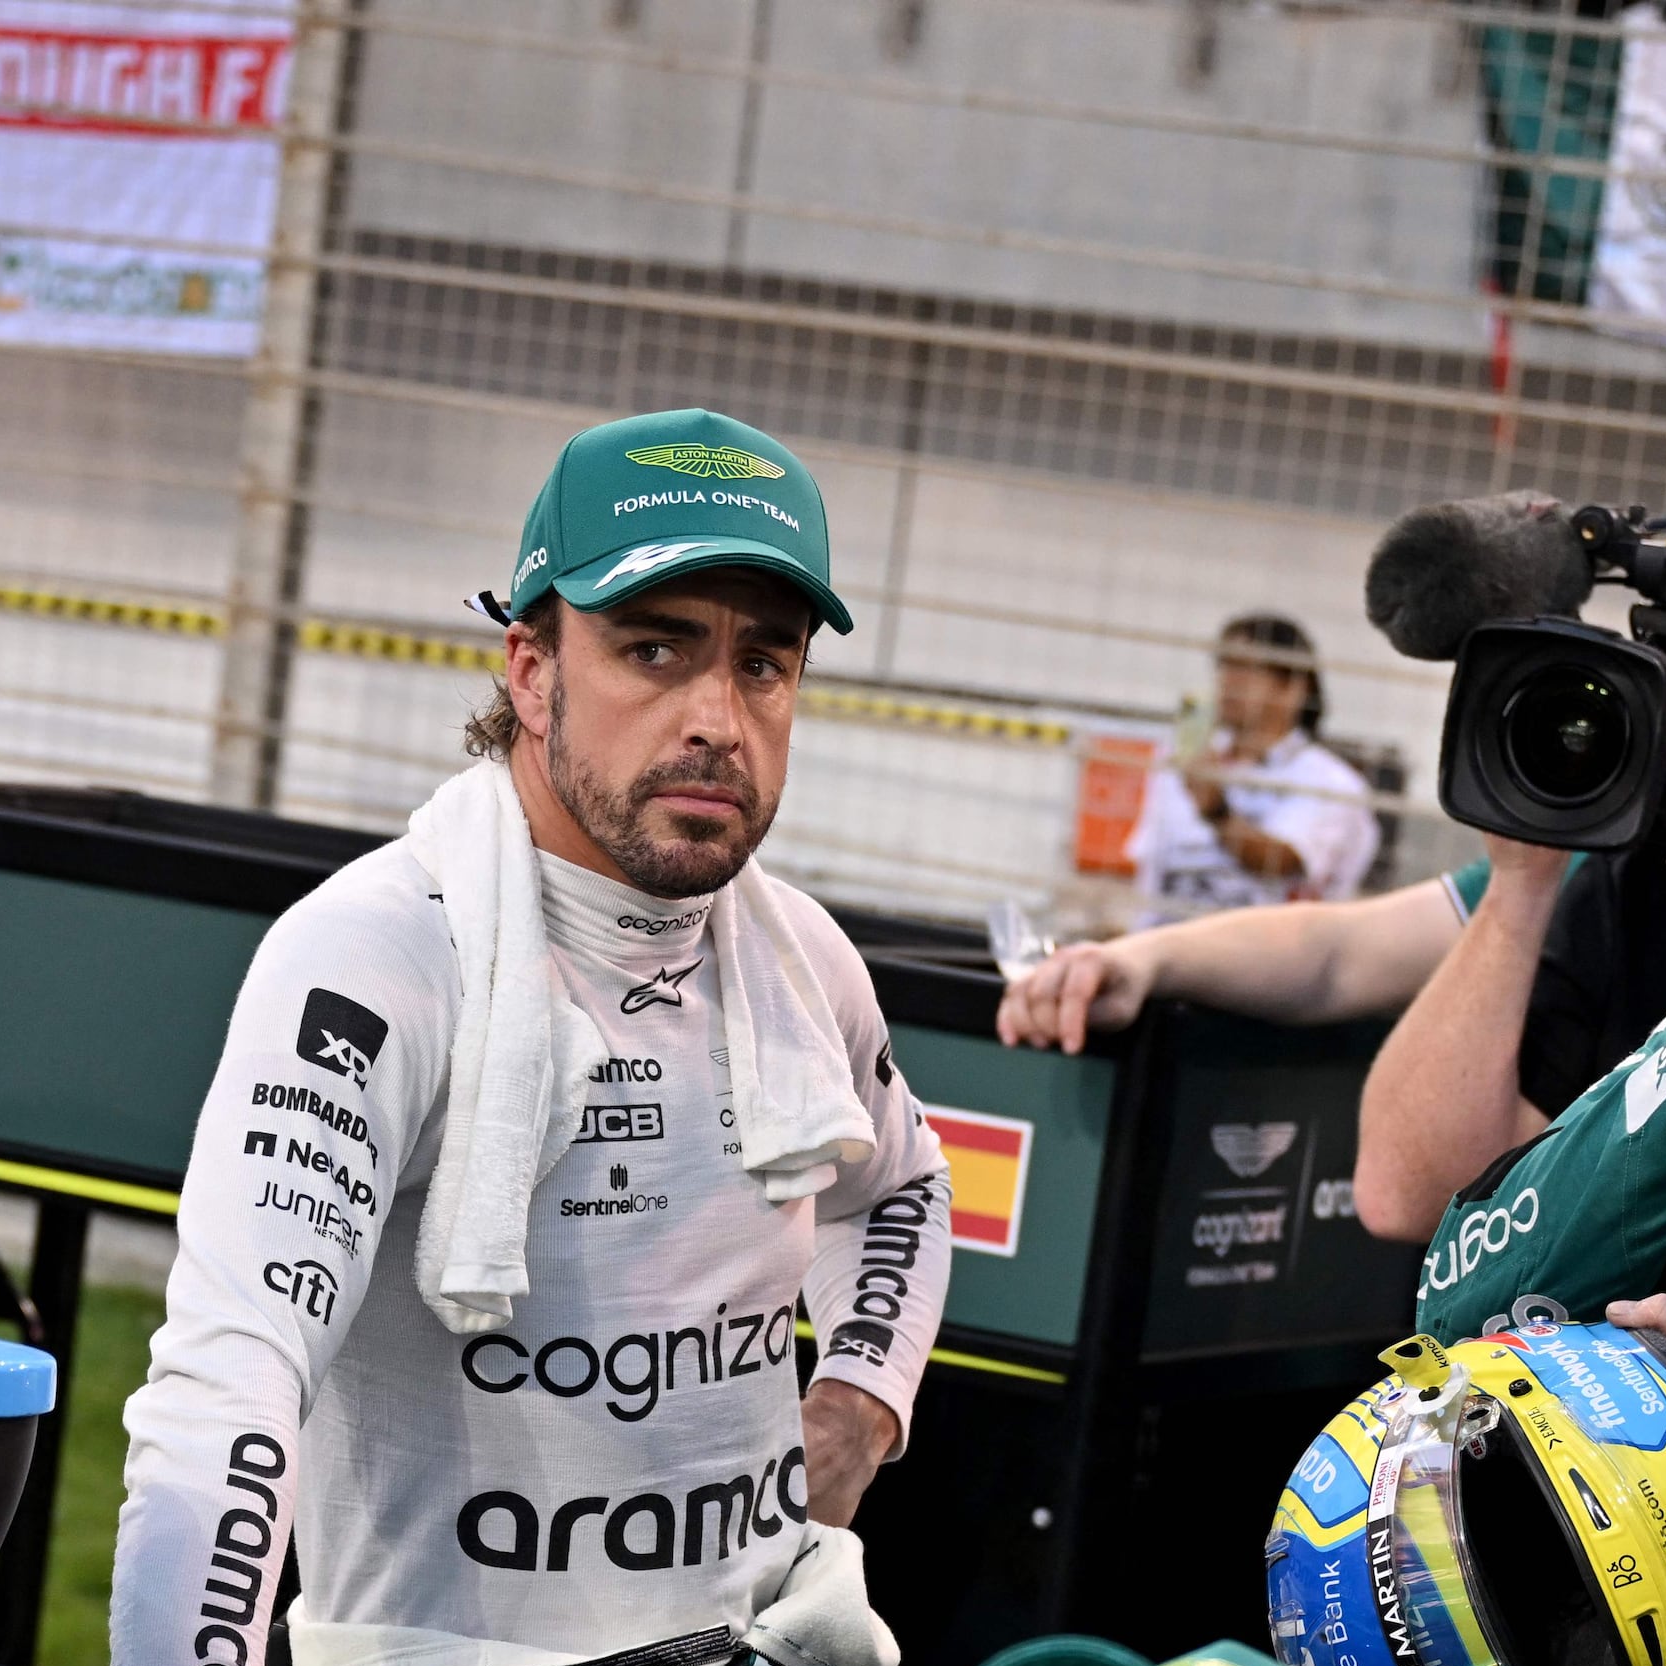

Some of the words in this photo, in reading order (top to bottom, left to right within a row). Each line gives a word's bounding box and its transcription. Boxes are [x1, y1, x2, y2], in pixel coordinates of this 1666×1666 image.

[674, 449, 709, 460] ASTON
[711, 452, 749, 466] MARTIN
[613, 489, 707, 517] FORMULA
[760, 499, 801, 533] TEAM
[513, 546, 549, 594] aramco
[560, 1194, 668, 1217] SentinelOne
[263, 1259, 340, 1327] citi
[461, 1302, 796, 1423] cogniza
[1421, 1335, 1449, 1370] kimoa
[1536, 1340, 1627, 1431] finetwork
[456, 1445, 809, 1573] aramco
[1372, 1460, 1390, 1507] PERONI
[1319, 1558, 1348, 1646] Bank
[1370, 1528, 1417, 1658] MARTIN
